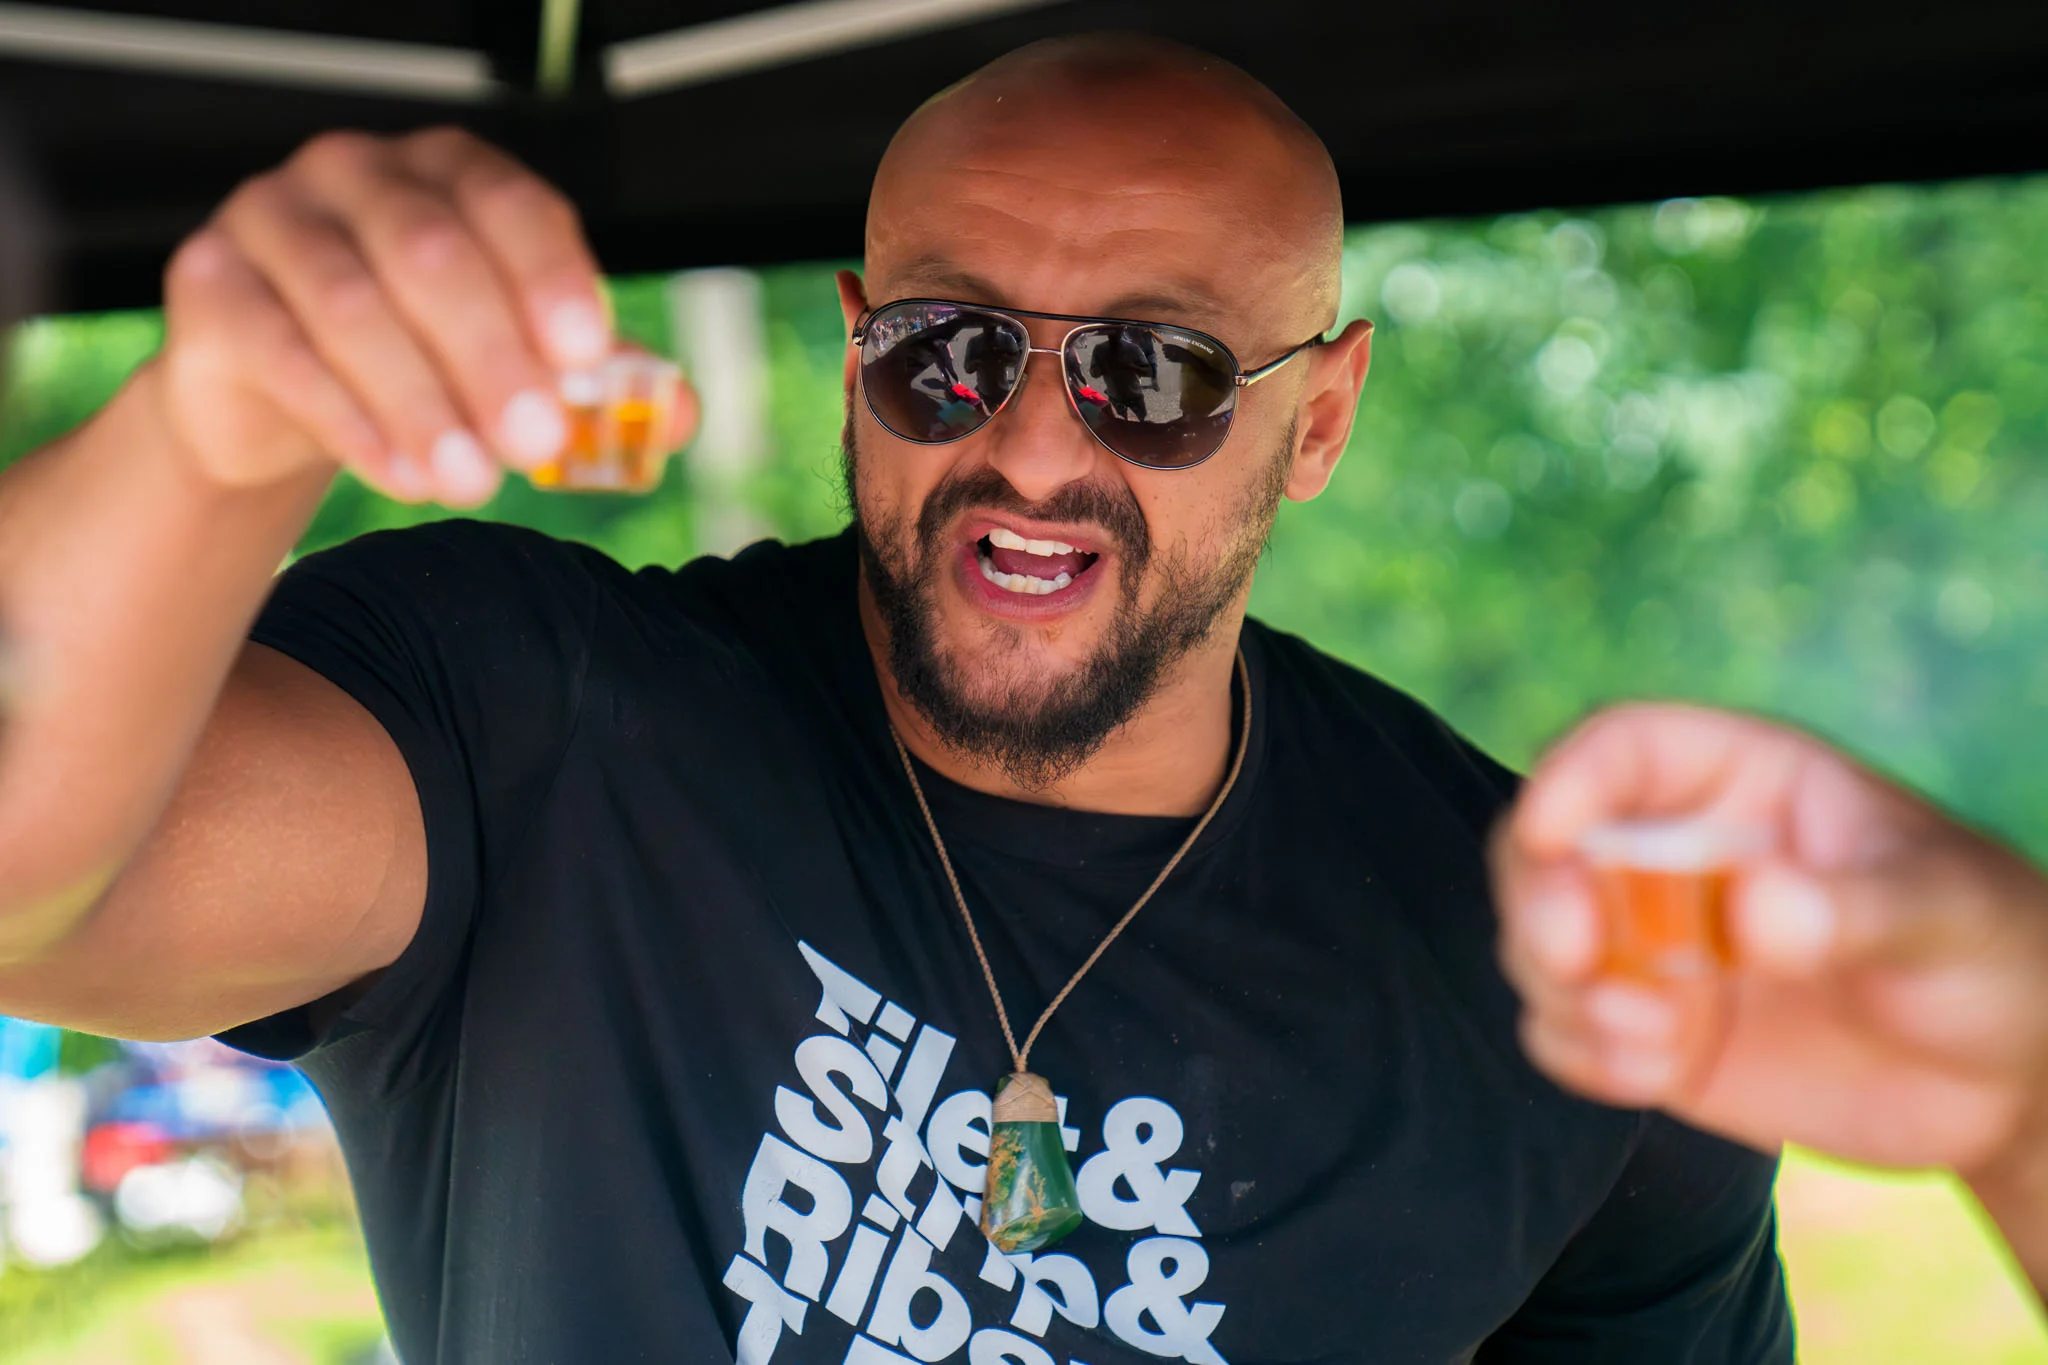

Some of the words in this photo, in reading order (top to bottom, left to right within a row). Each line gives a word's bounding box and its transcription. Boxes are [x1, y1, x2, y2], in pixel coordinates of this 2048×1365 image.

[1076, 1095, 1203, 1238] &
[741, 1131, 973, 1363] Rib
[1103, 1236, 1231, 1365] &
